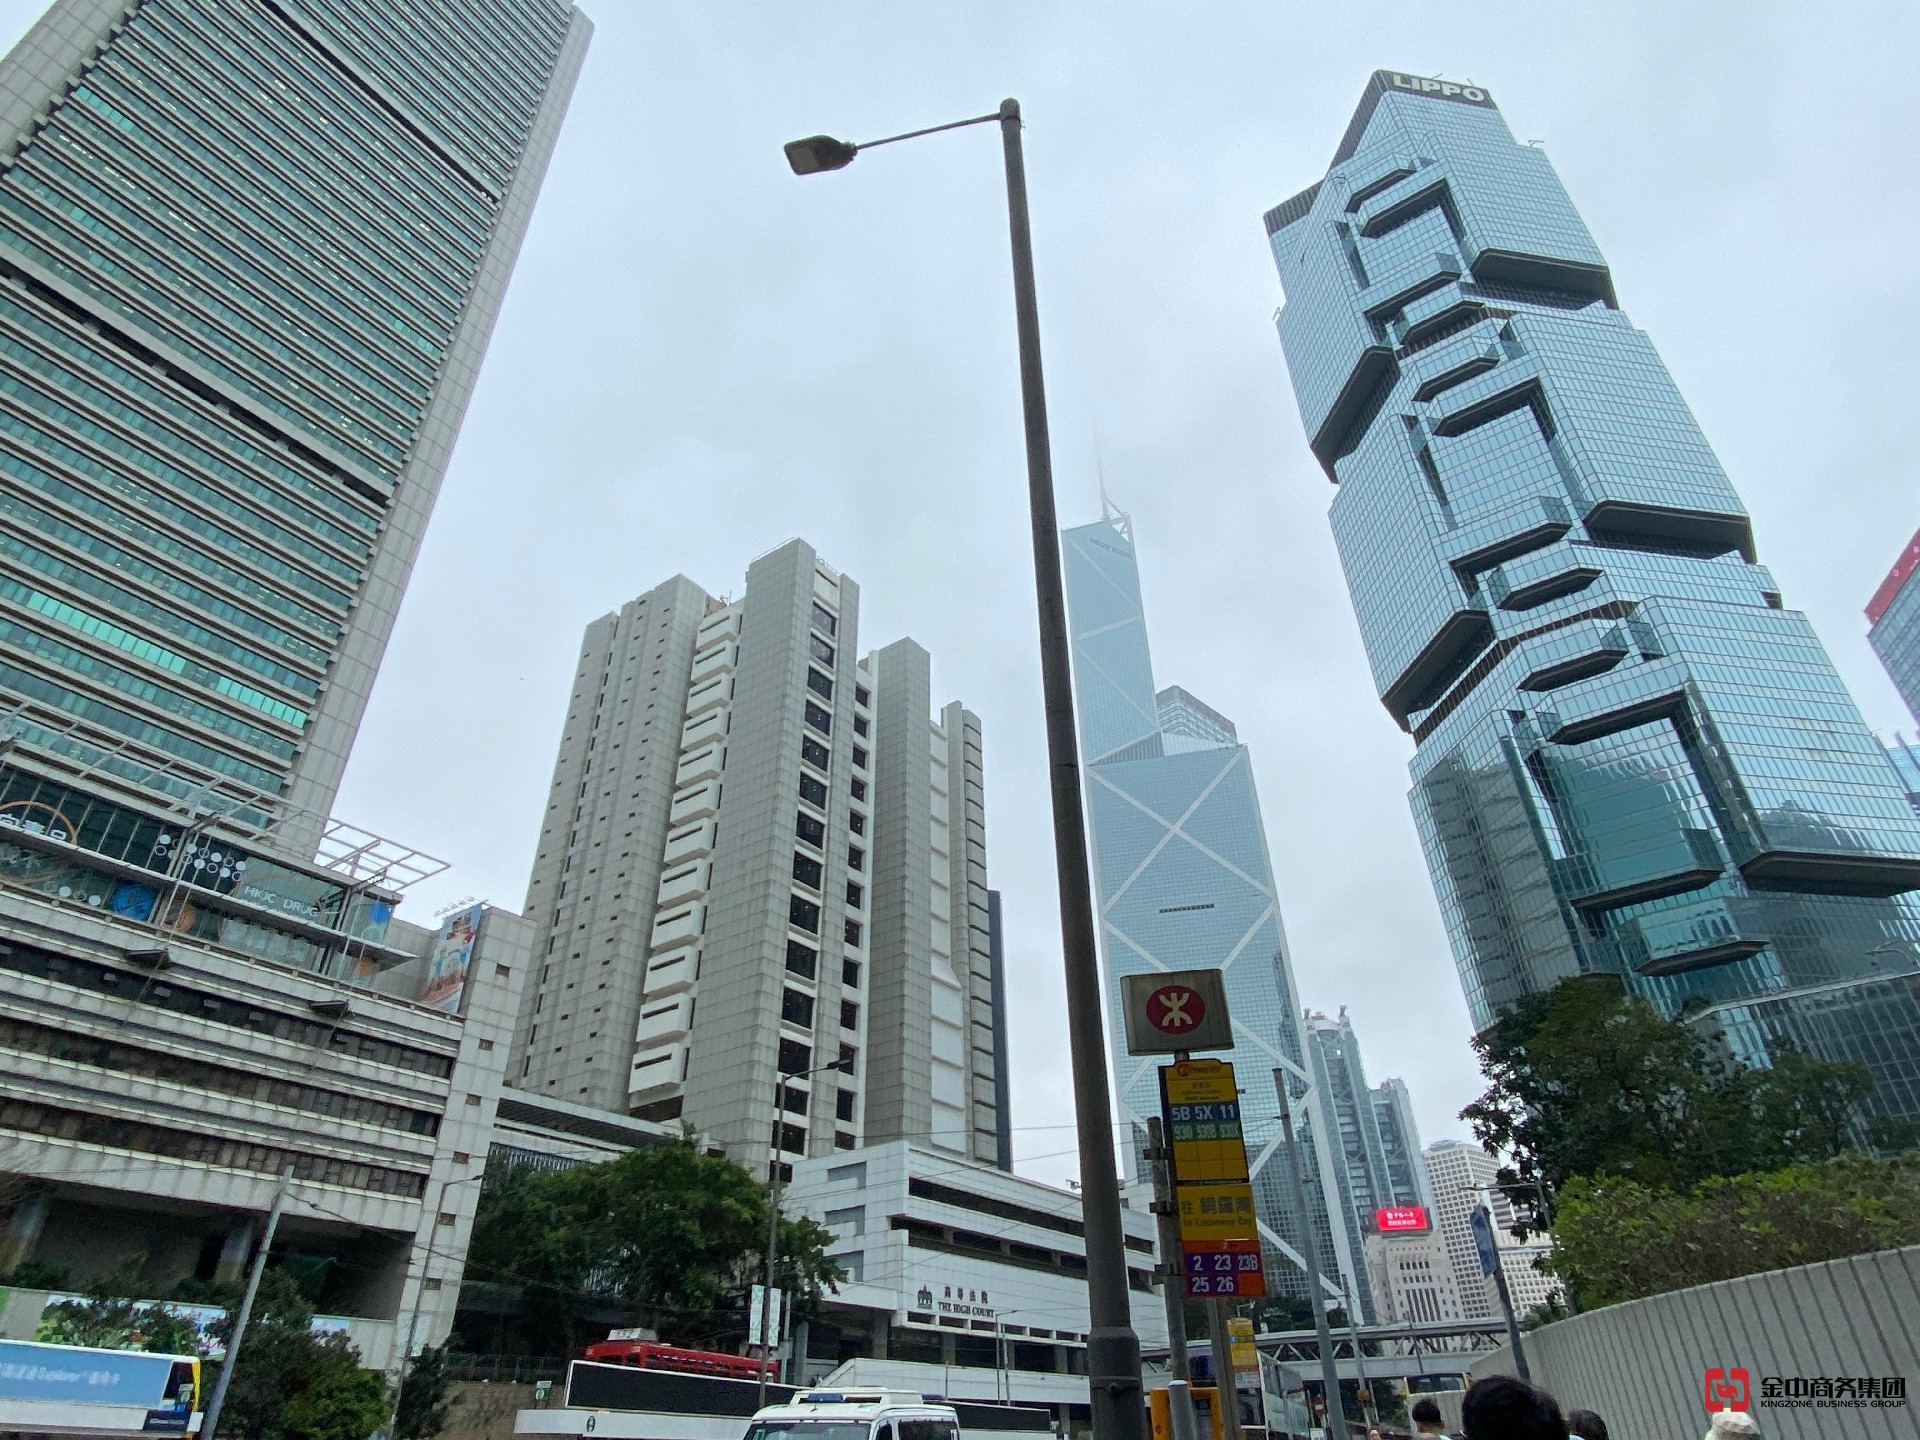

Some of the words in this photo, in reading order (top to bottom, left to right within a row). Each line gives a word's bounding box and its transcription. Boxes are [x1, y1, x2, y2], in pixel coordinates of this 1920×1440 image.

[1392, 73, 1485, 102] LIPPO
[243, 885, 278, 904] HKJC
[283, 898, 320, 917] DRUG
[1171, 1106, 1191, 1121] 5B
[1194, 1105, 1214, 1120] 5X
[1220, 1104, 1236, 1119] 11
[1193, 1255, 1204, 1271] 2
[1214, 1254, 1232, 1271] 23
[1238, 1254, 1259, 1271] 23B
[1192, 1276, 1210, 1293] 25
[1216, 1276, 1235, 1293] 26
[937, 1301, 952, 1312] THE
[953, 1303, 971, 1315] HIGH
[972, 1306, 995, 1318] COURT
